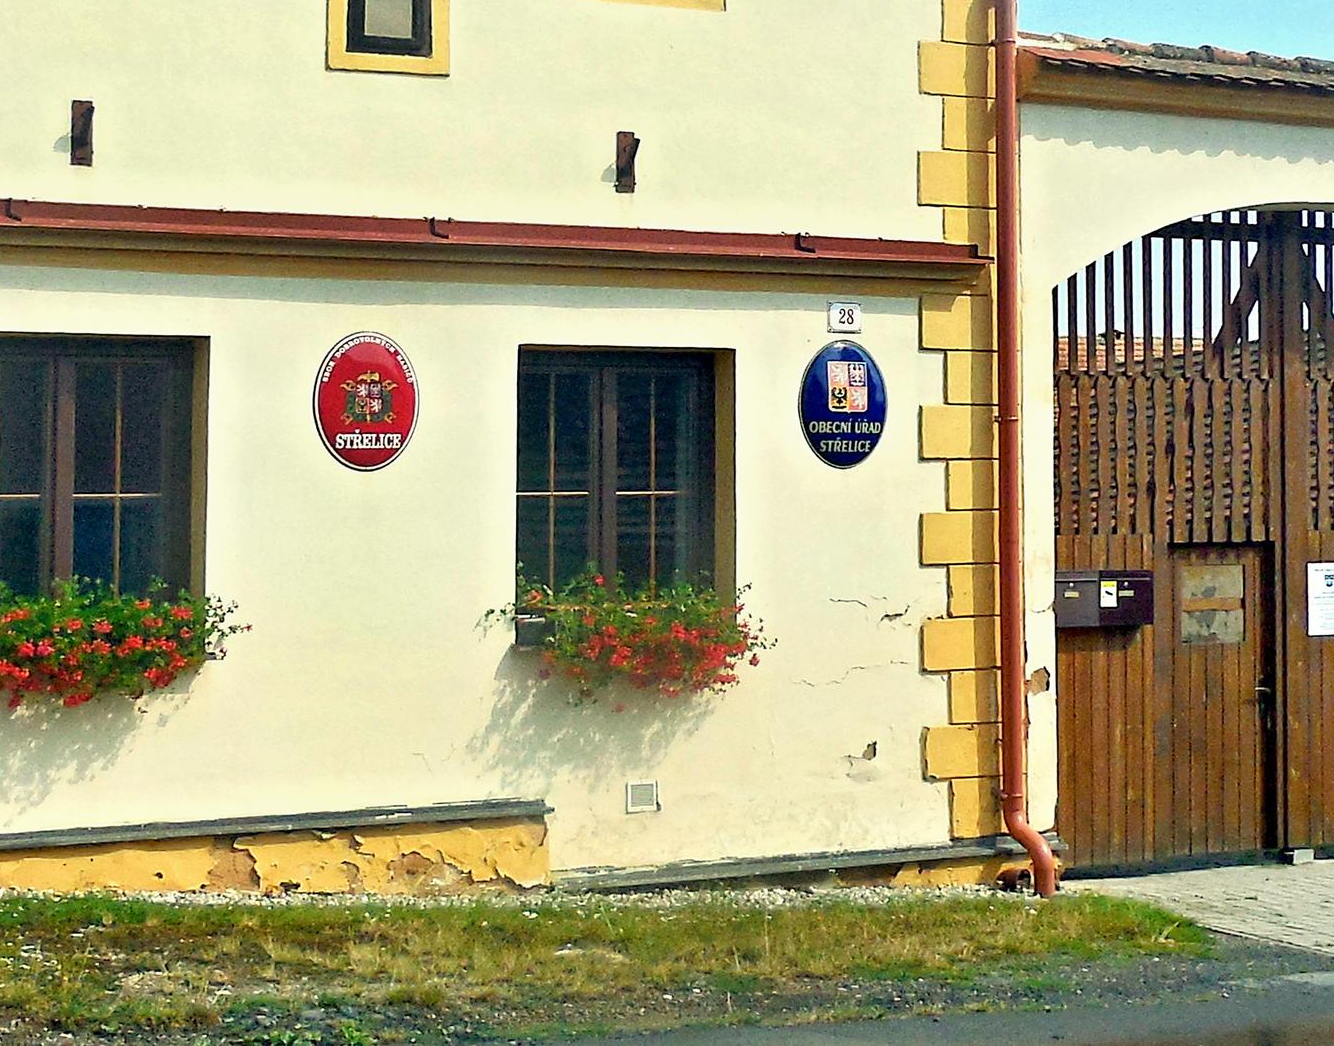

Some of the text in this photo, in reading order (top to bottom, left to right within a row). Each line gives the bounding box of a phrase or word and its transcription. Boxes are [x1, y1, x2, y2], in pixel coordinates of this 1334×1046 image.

[838, 308, 854, 325] 28
[809, 418, 881, 434] OBECNÍ ÚŘAD
[335, 429, 402, 449] STŘELICE
[819, 437, 871, 452] STŘELICE
